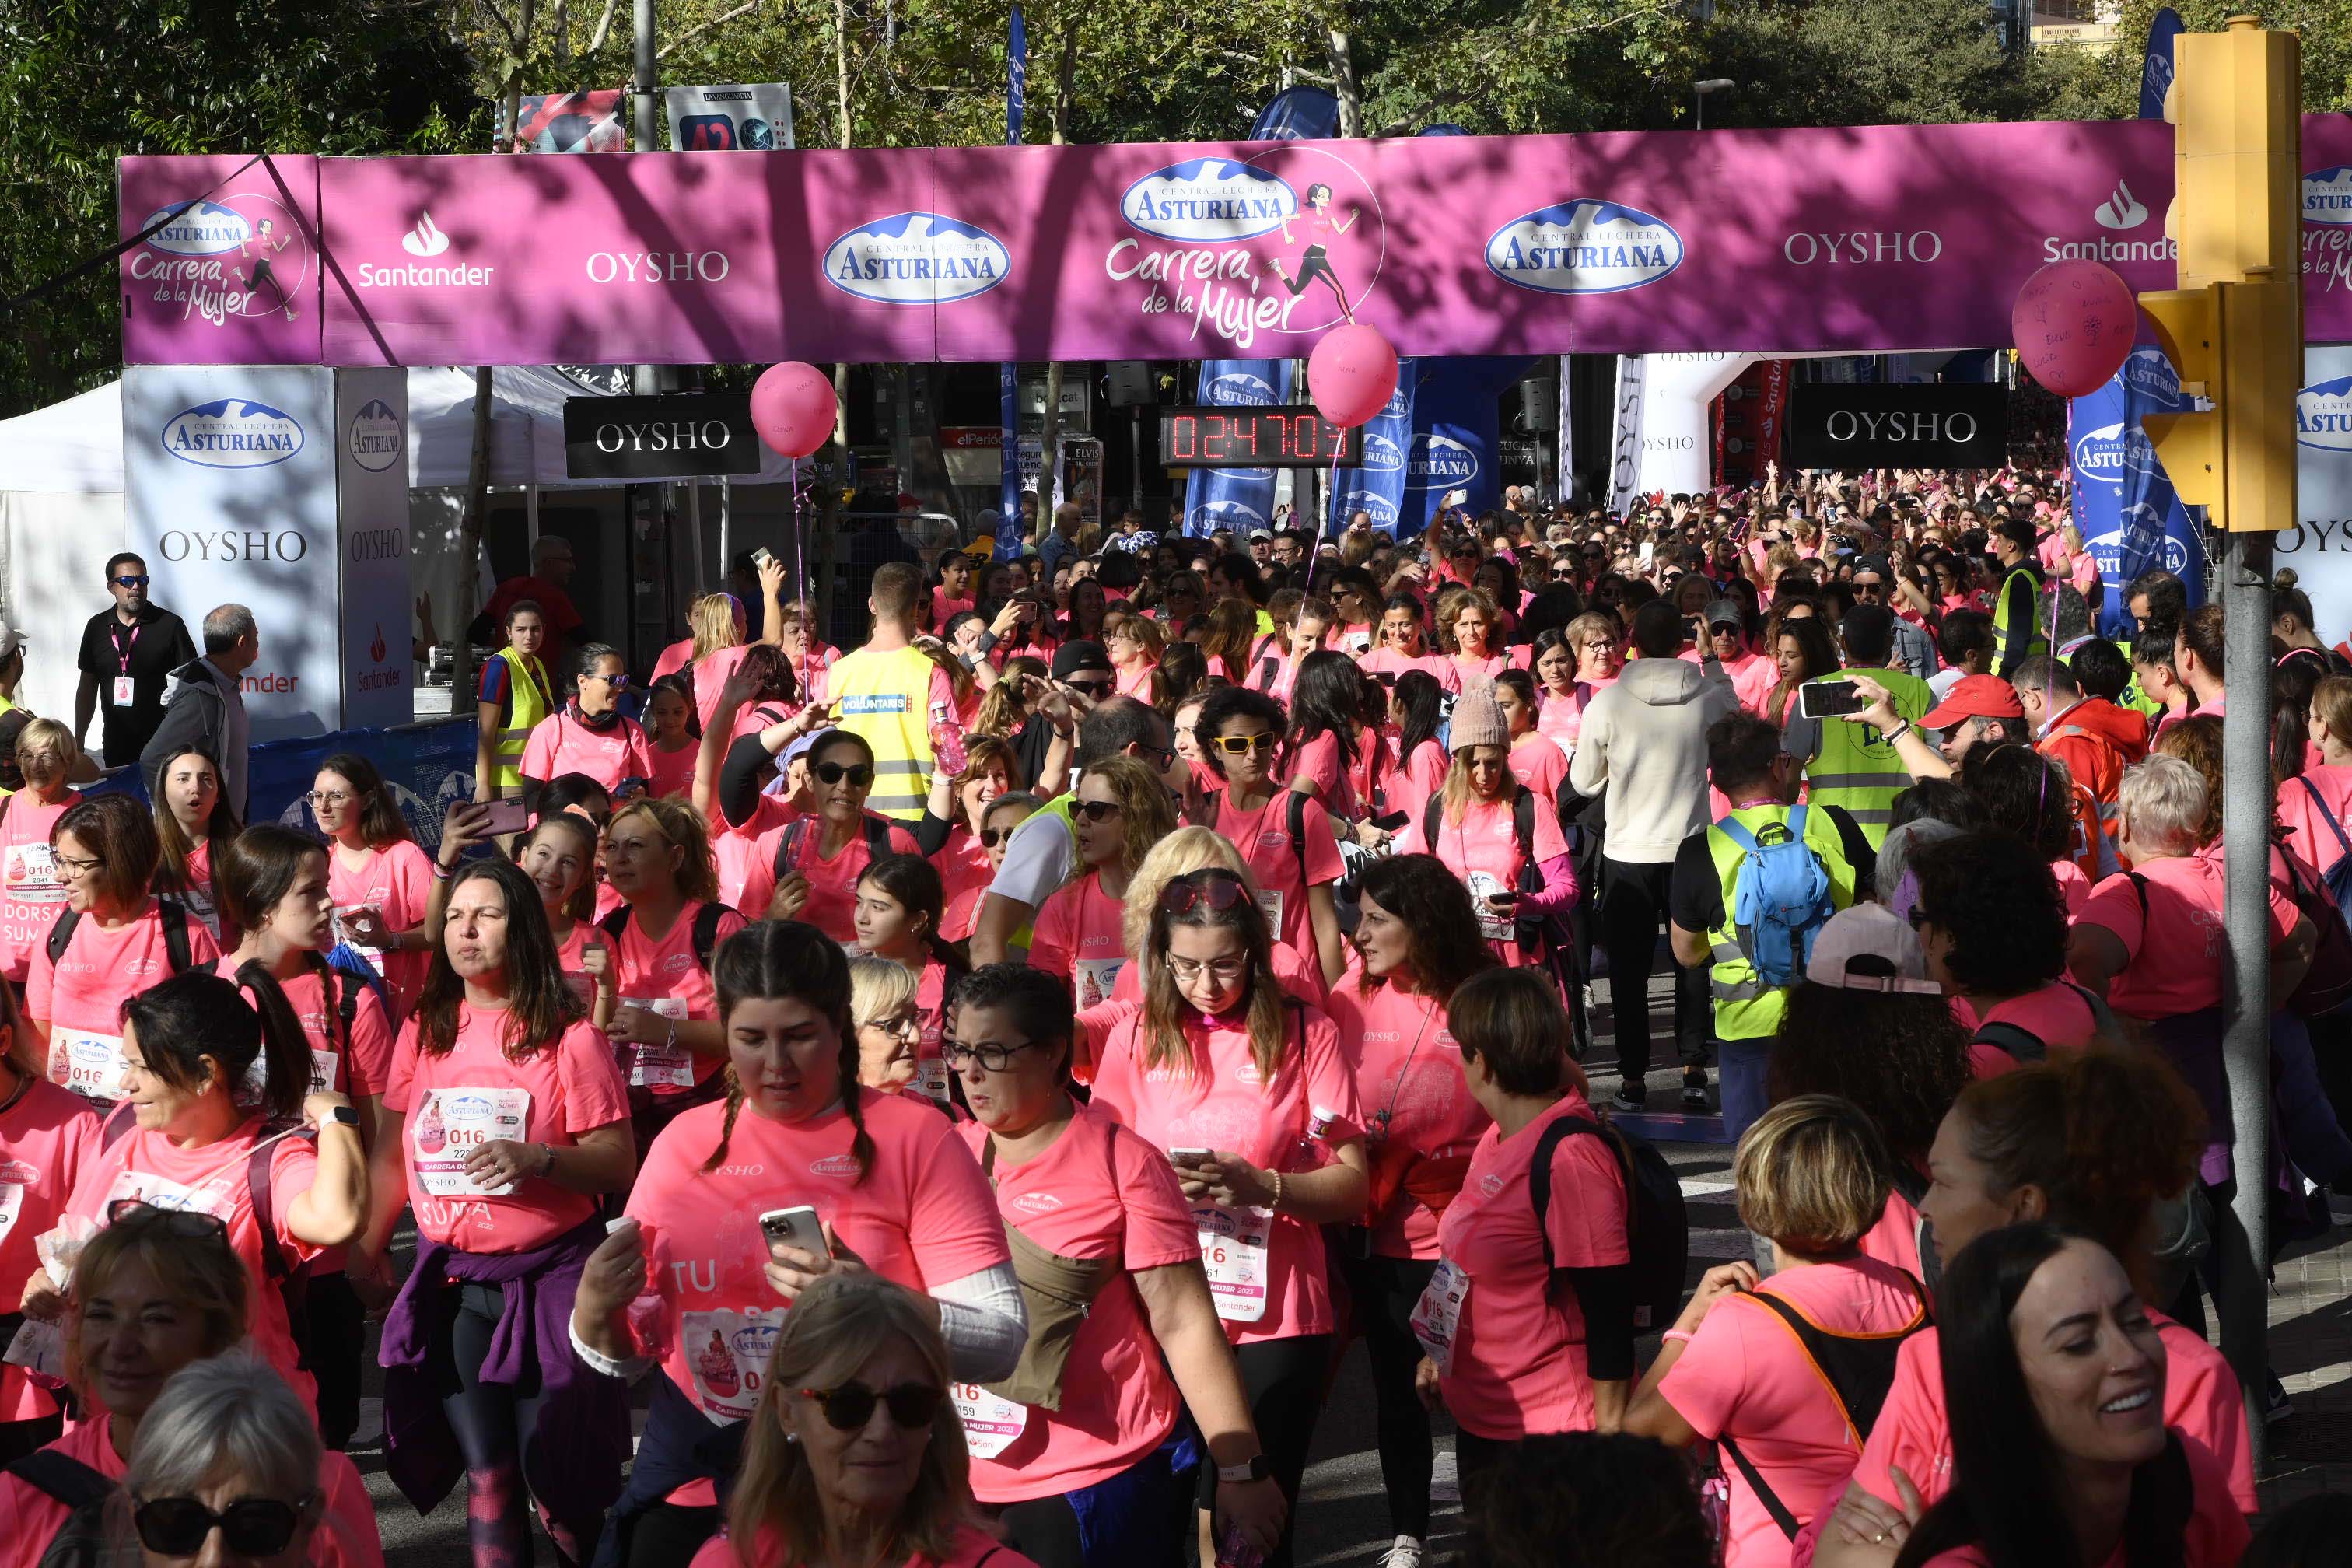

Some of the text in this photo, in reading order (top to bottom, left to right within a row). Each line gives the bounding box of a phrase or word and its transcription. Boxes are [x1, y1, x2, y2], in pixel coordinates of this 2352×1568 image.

[1162, 186, 1216, 194] CENTRAL
[1134, 190, 1283, 220] ASTURIANA
[866, 242, 990, 253] CENTRAL LECHERA
[1531, 230, 1661, 242] CENTRAL LECHERA
[1784, 231, 1942, 264] OYSHO
[131, 252, 222, 280] Carrera
[837, 246, 996, 281] ASTURIANA
[1105, 237, 1251, 281] Carrera
[1500, 236, 1668, 270] ASTURIANA
[359, 262, 495, 288] Santander
[586, 250, 730, 283] OYSHO
[153, 278, 257, 327] de la Mujer
[1141, 275, 1305, 349] de la Mujer
[173, 424, 294, 451] ASTURIANA
[596, 420, 730, 453] OYSHO
[1827, 411, 1976, 443] OYSHO
[354, 426, 398, 455] ASTURIANA
[1075, 448, 1100, 458] ELVIS
[159, 530, 306, 562] OYSHO
[352, 527, 403, 562] OYSHO
[239, 672, 299, 694] nder
[357, 666, 402, 693] Santander
[843, 698, 905, 710] VOLUNTARIS
[28, 866, 53, 875] 016
[73, 1067, 103, 1083] 016
[79, 1084, 92, 1095] 557
[448, 1104, 491, 1115] ASTURIANA
[450, 1129, 485, 1145] 016
[421, 1178, 457, 1188] OYSHO
[670, 1259, 716, 1295] TU
[1210, 1283, 1255, 1295] MUJER 2023
[1217, 1300, 1256, 1312] Santander
[744, 1370, 766, 1391] 0
[969, 1422, 995, 1432] MUJER
[997, 1425, 1014, 1433] 2023
